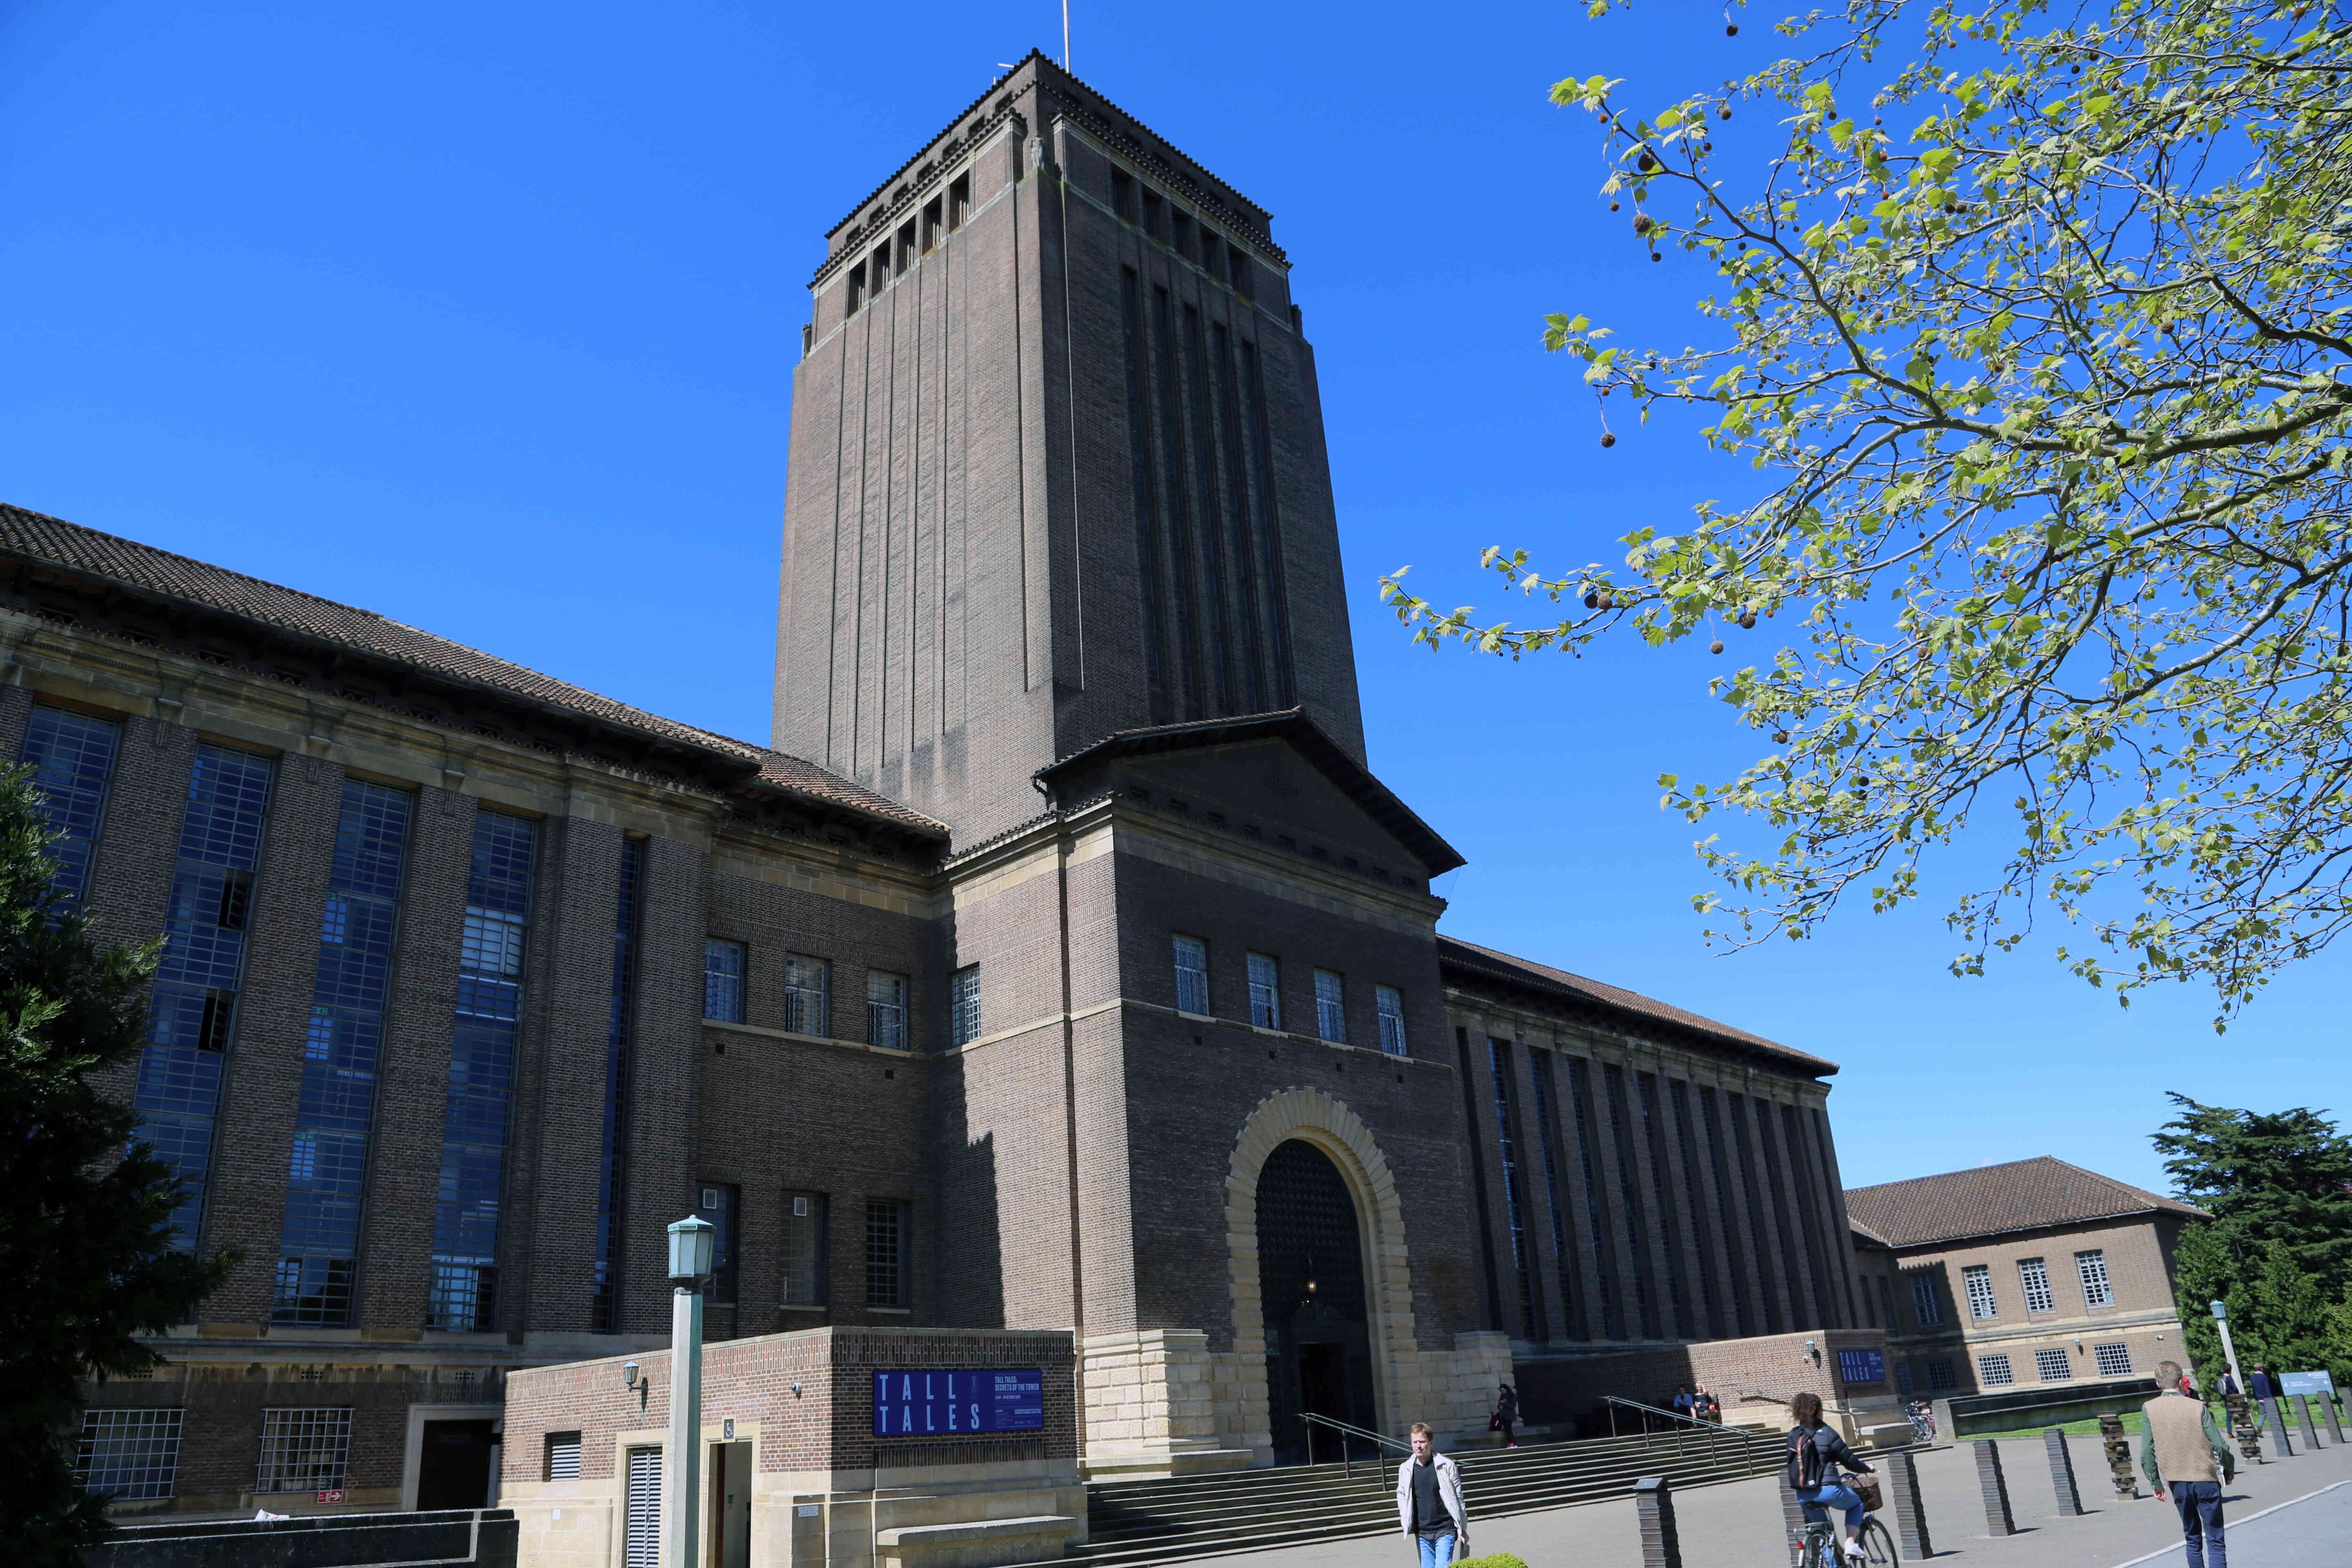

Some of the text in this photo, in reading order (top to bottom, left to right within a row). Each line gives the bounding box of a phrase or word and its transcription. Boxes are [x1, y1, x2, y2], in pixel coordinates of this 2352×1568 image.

[1842, 1366, 1869, 1381] TALES
[880, 1374, 956, 1401] TALL
[879, 1404, 979, 1433] TALES
